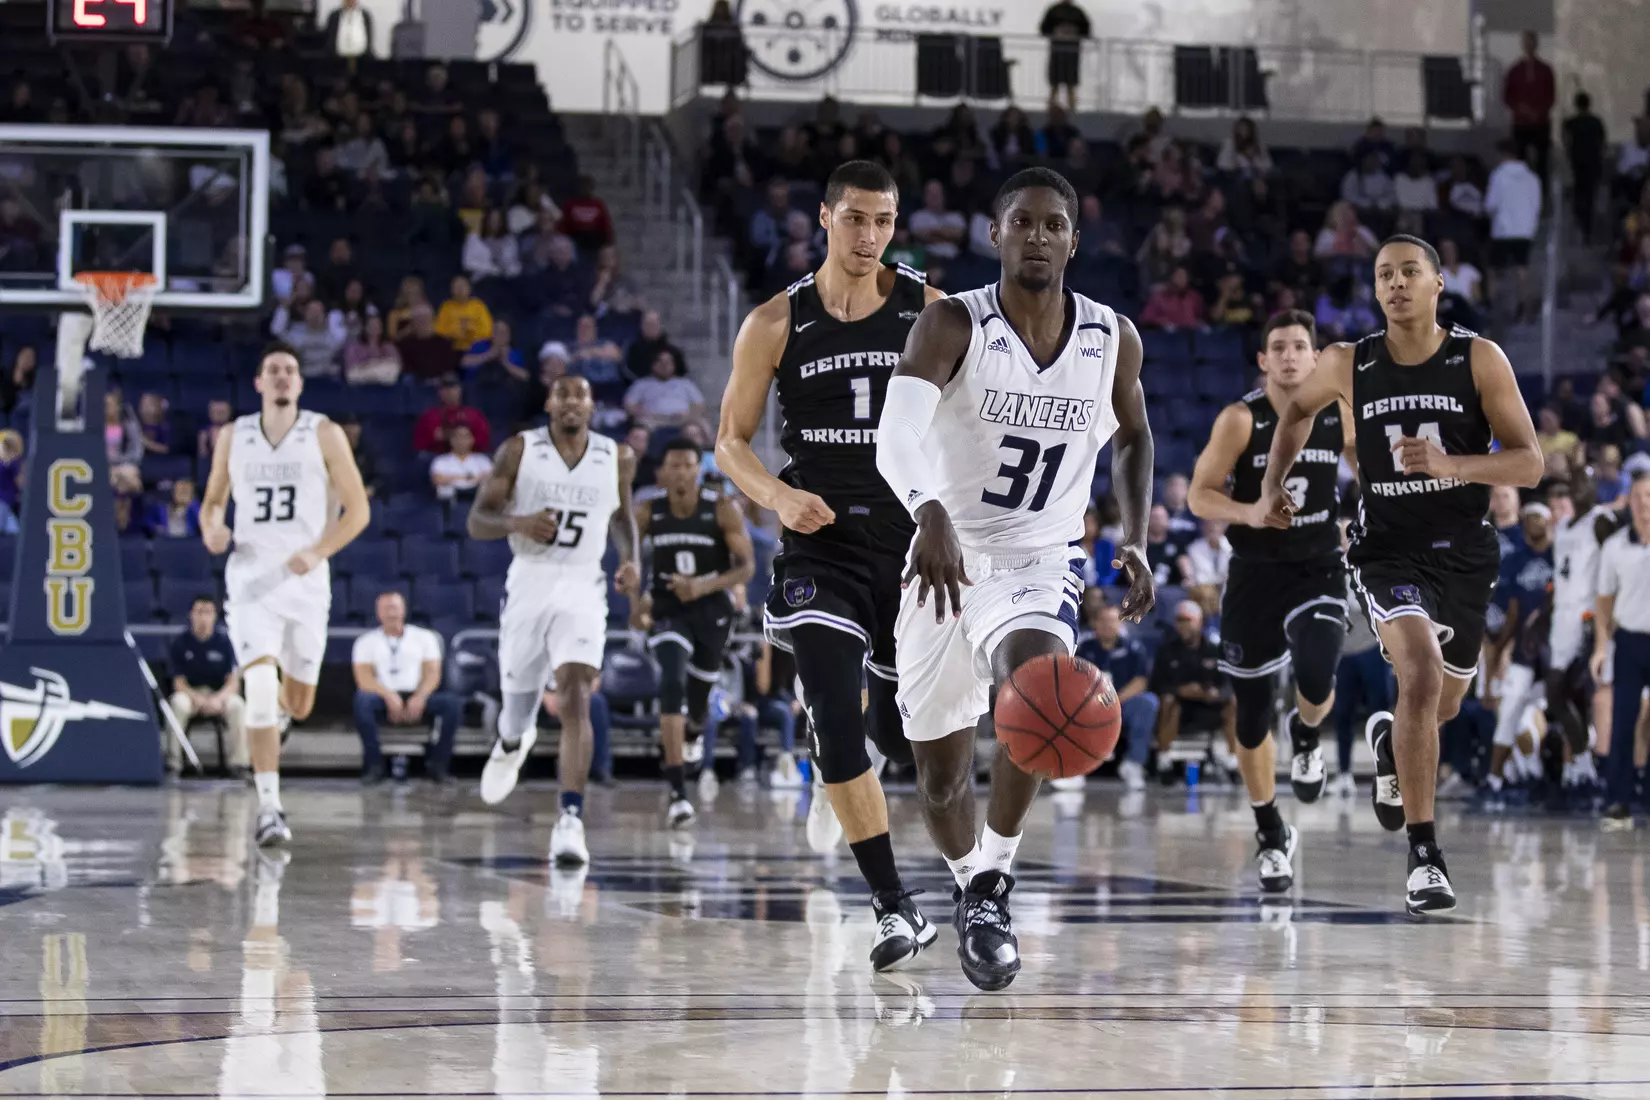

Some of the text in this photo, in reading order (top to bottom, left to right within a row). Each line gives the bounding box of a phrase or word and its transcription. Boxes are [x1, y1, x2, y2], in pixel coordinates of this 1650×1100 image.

[551, 13, 671, 35] TO SERVE
[874, 5, 1004, 26] GLOBALLY
[800, 351, 904, 379] CENTRA
[1079, 347, 1102, 359] WAC
[850, 376, 871, 420] 1
[979, 388, 1095, 432] LANCERS
[1362, 394, 1465, 420] CENTRAL
[1253, 448, 1338, 468] CTRAL
[981, 434, 1068, 512] 31
[253, 486, 296, 523] 33
[1284, 476, 1310, 510] 3
[44, 458, 95, 637] CBU
[674, 550, 697, 576] 0
[1559, 554, 1571, 581] 4
